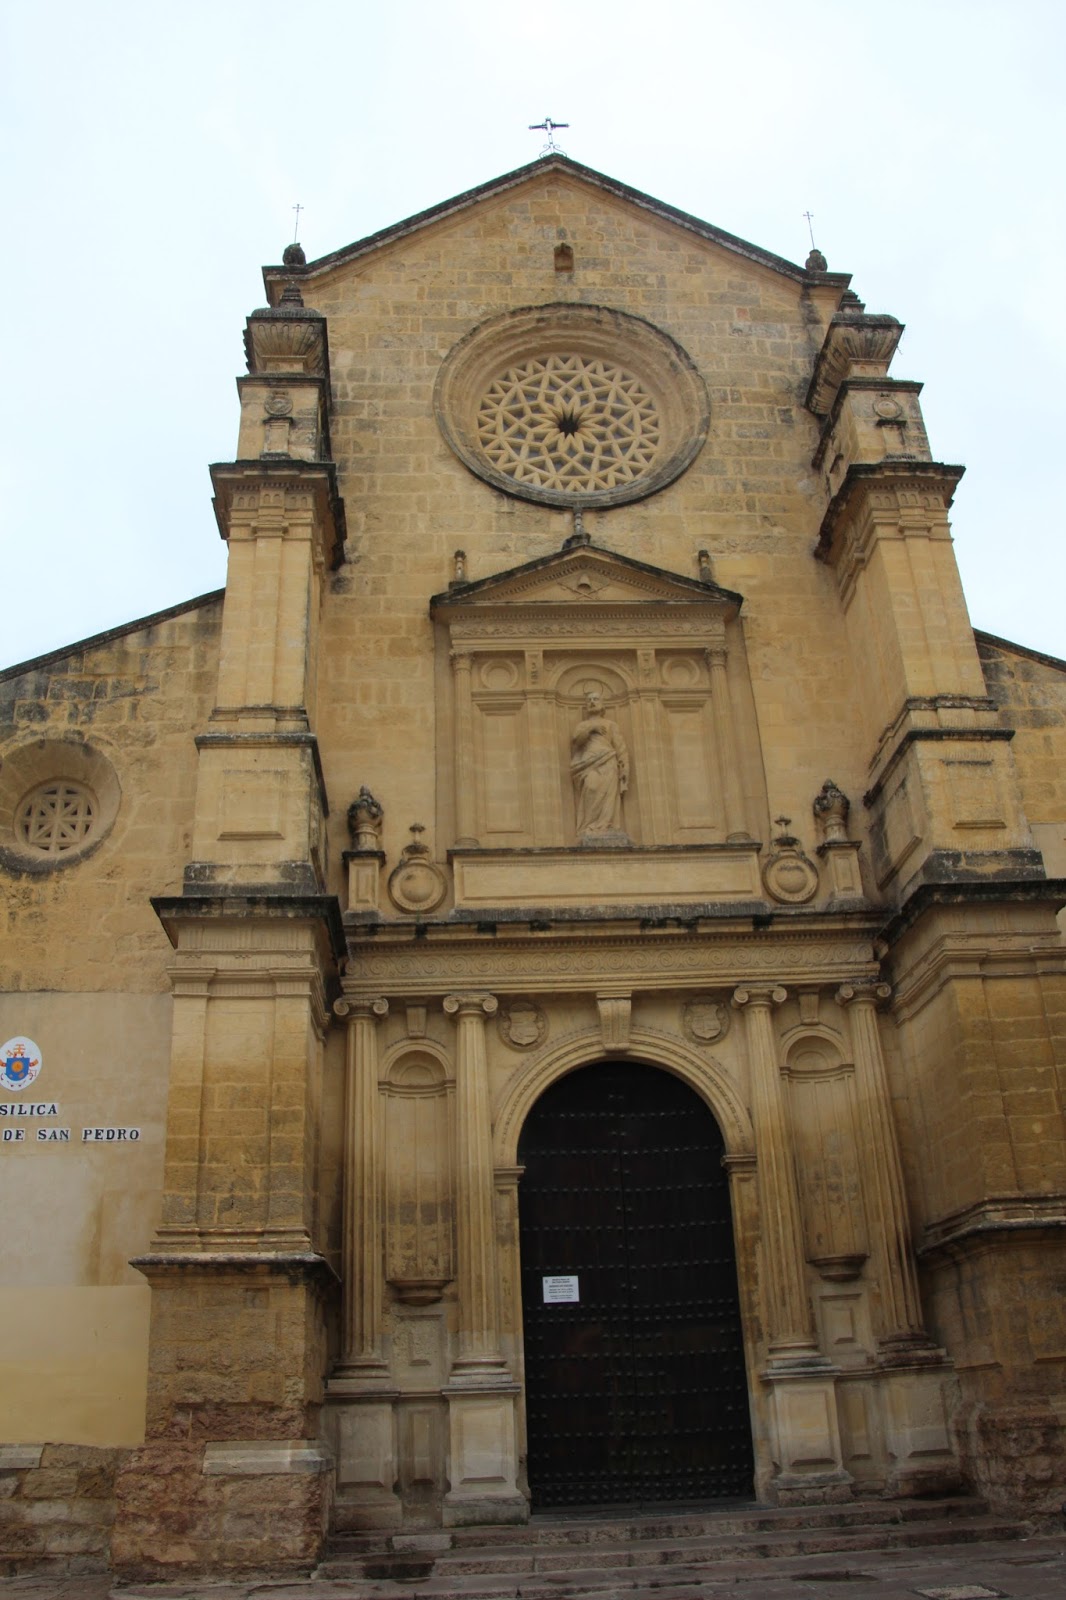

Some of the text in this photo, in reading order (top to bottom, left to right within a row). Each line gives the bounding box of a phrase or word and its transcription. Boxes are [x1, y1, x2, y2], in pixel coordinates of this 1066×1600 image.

[3, 1128, 140, 1141] DE SAN PEDRO
